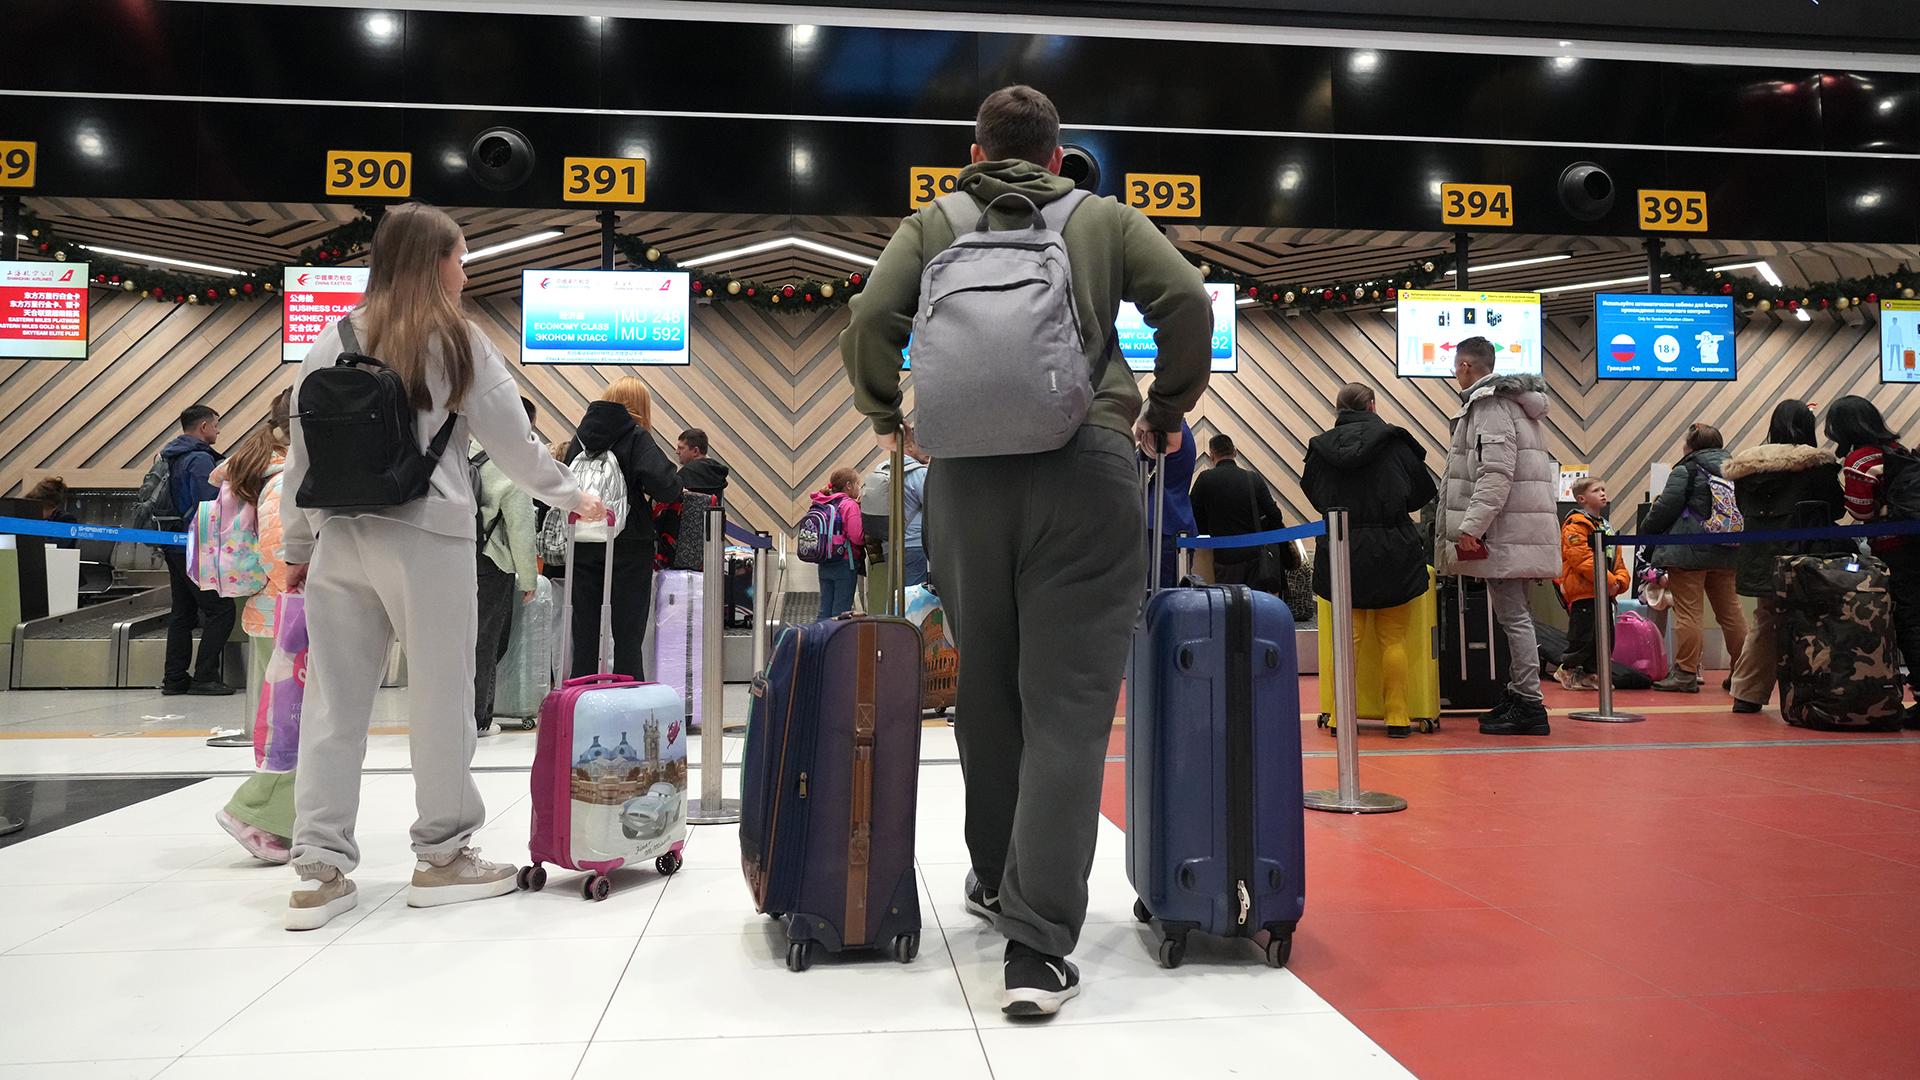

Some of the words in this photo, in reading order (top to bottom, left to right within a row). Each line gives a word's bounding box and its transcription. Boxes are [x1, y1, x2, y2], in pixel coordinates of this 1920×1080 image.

[0, 148, 30, 179] 9
[332, 158, 406, 189] 390
[569, 165, 635, 195] 391
[915, 174, 959, 202] 39
[1131, 180, 1196, 210] 393
[1446, 190, 1510, 219] 394
[1643, 196, 1703, 224] 395
[289, 304, 331, 312] BUSINESS
[331, 305, 357, 313] CLAS
[621, 309, 647, 323] MU
[289, 314, 324, 322] БИЗНЕС
[534, 322, 578, 331] ECONOMY
[580, 322, 609, 331] CLASS
[621, 326, 647, 341] MU
[652, 327, 681, 341] 592
[288, 334, 305, 342] SKY
[535, 333, 575, 342] ЭКОНОМ
[577, 333, 609, 342] КЛАСС
[1658, 344, 1675, 353] 18+
